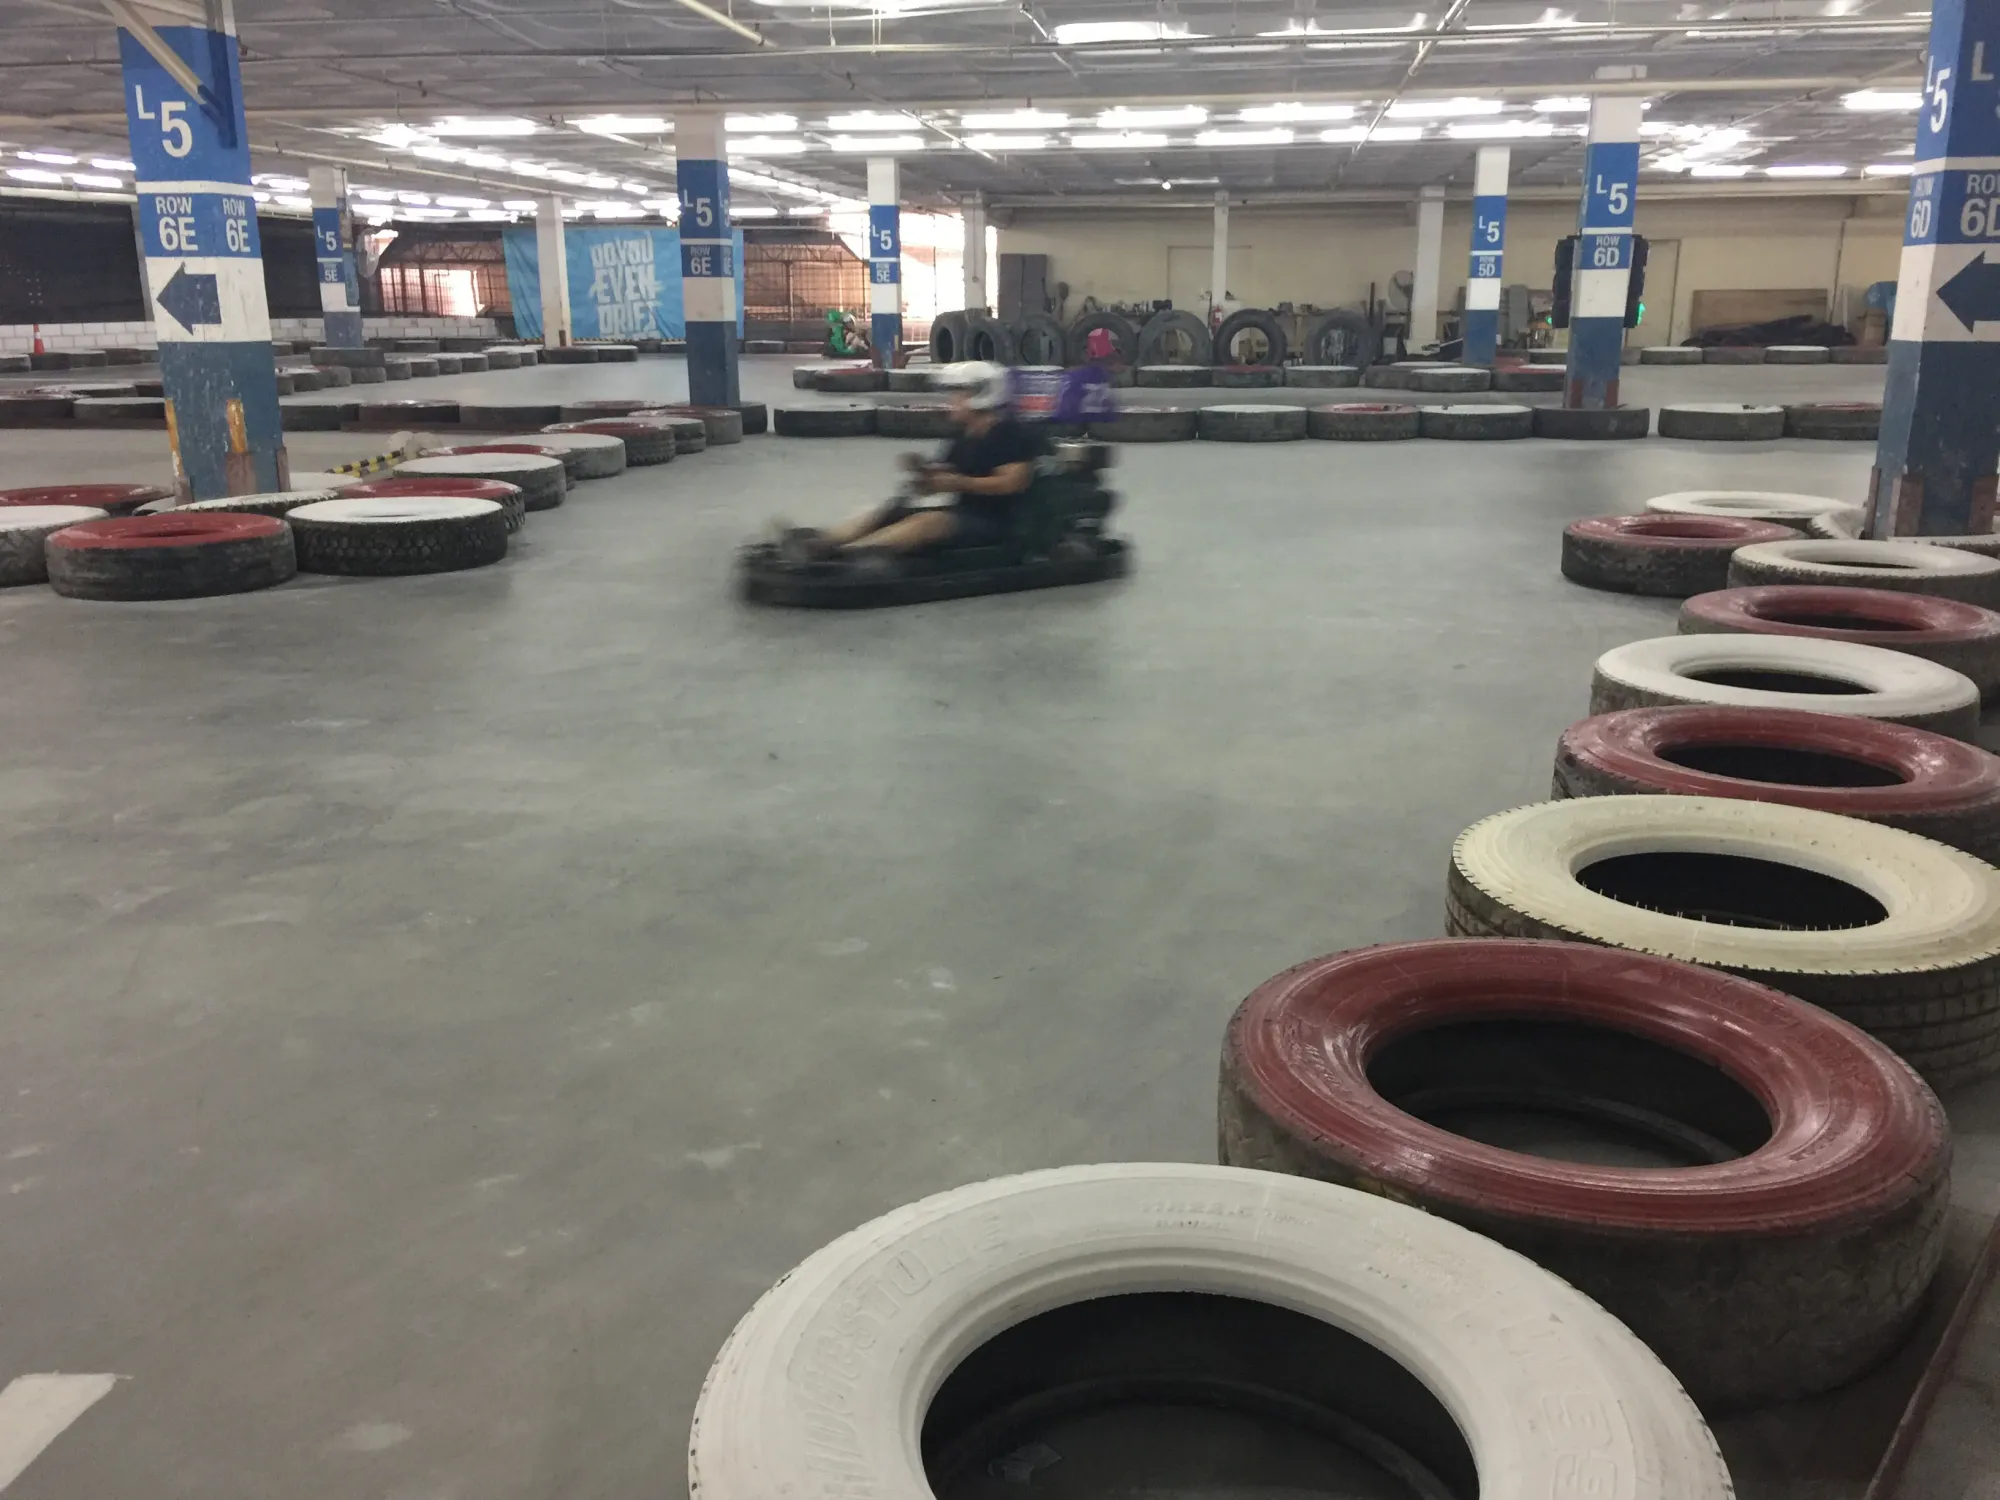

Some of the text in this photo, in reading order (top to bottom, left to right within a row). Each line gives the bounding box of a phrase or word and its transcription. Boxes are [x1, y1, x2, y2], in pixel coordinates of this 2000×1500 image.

[1971, 41, 1994, 82] L
[1926, 55, 1951, 133] L 5
[135, 84, 192, 157] L 5
[1596, 174, 1607, 194] L
[1608, 183, 1628, 215] 5
[1966, 174, 2000, 195] RO
[155, 196, 192, 214] ROW
[223, 198, 245, 216] ROW
[684, 189, 713, 227] L 5
[1479, 216, 1500, 243] L 5
[1910, 200, 1931, 238] 6D
[159, 217, 198, 250] 6E
[226, 219, 251, 252] 6E
[317, 226, 337, 251] L 5
[872, 224, 892, 250] L 5
[1596, 236, 1620, 246] ROW
[690, 246, 711, 256] ROW
[1594, 247, 1620, 267] 6D
[325, 269, 337, 281] 5E
[691, 257, 711, 275] 6E
[877, 270, 890, 282] 5E
[1479, 264, 1496, 277] 5D
[594, 265, 657, 304] EVEN
[597, 300, 657, 335] DRIFT
